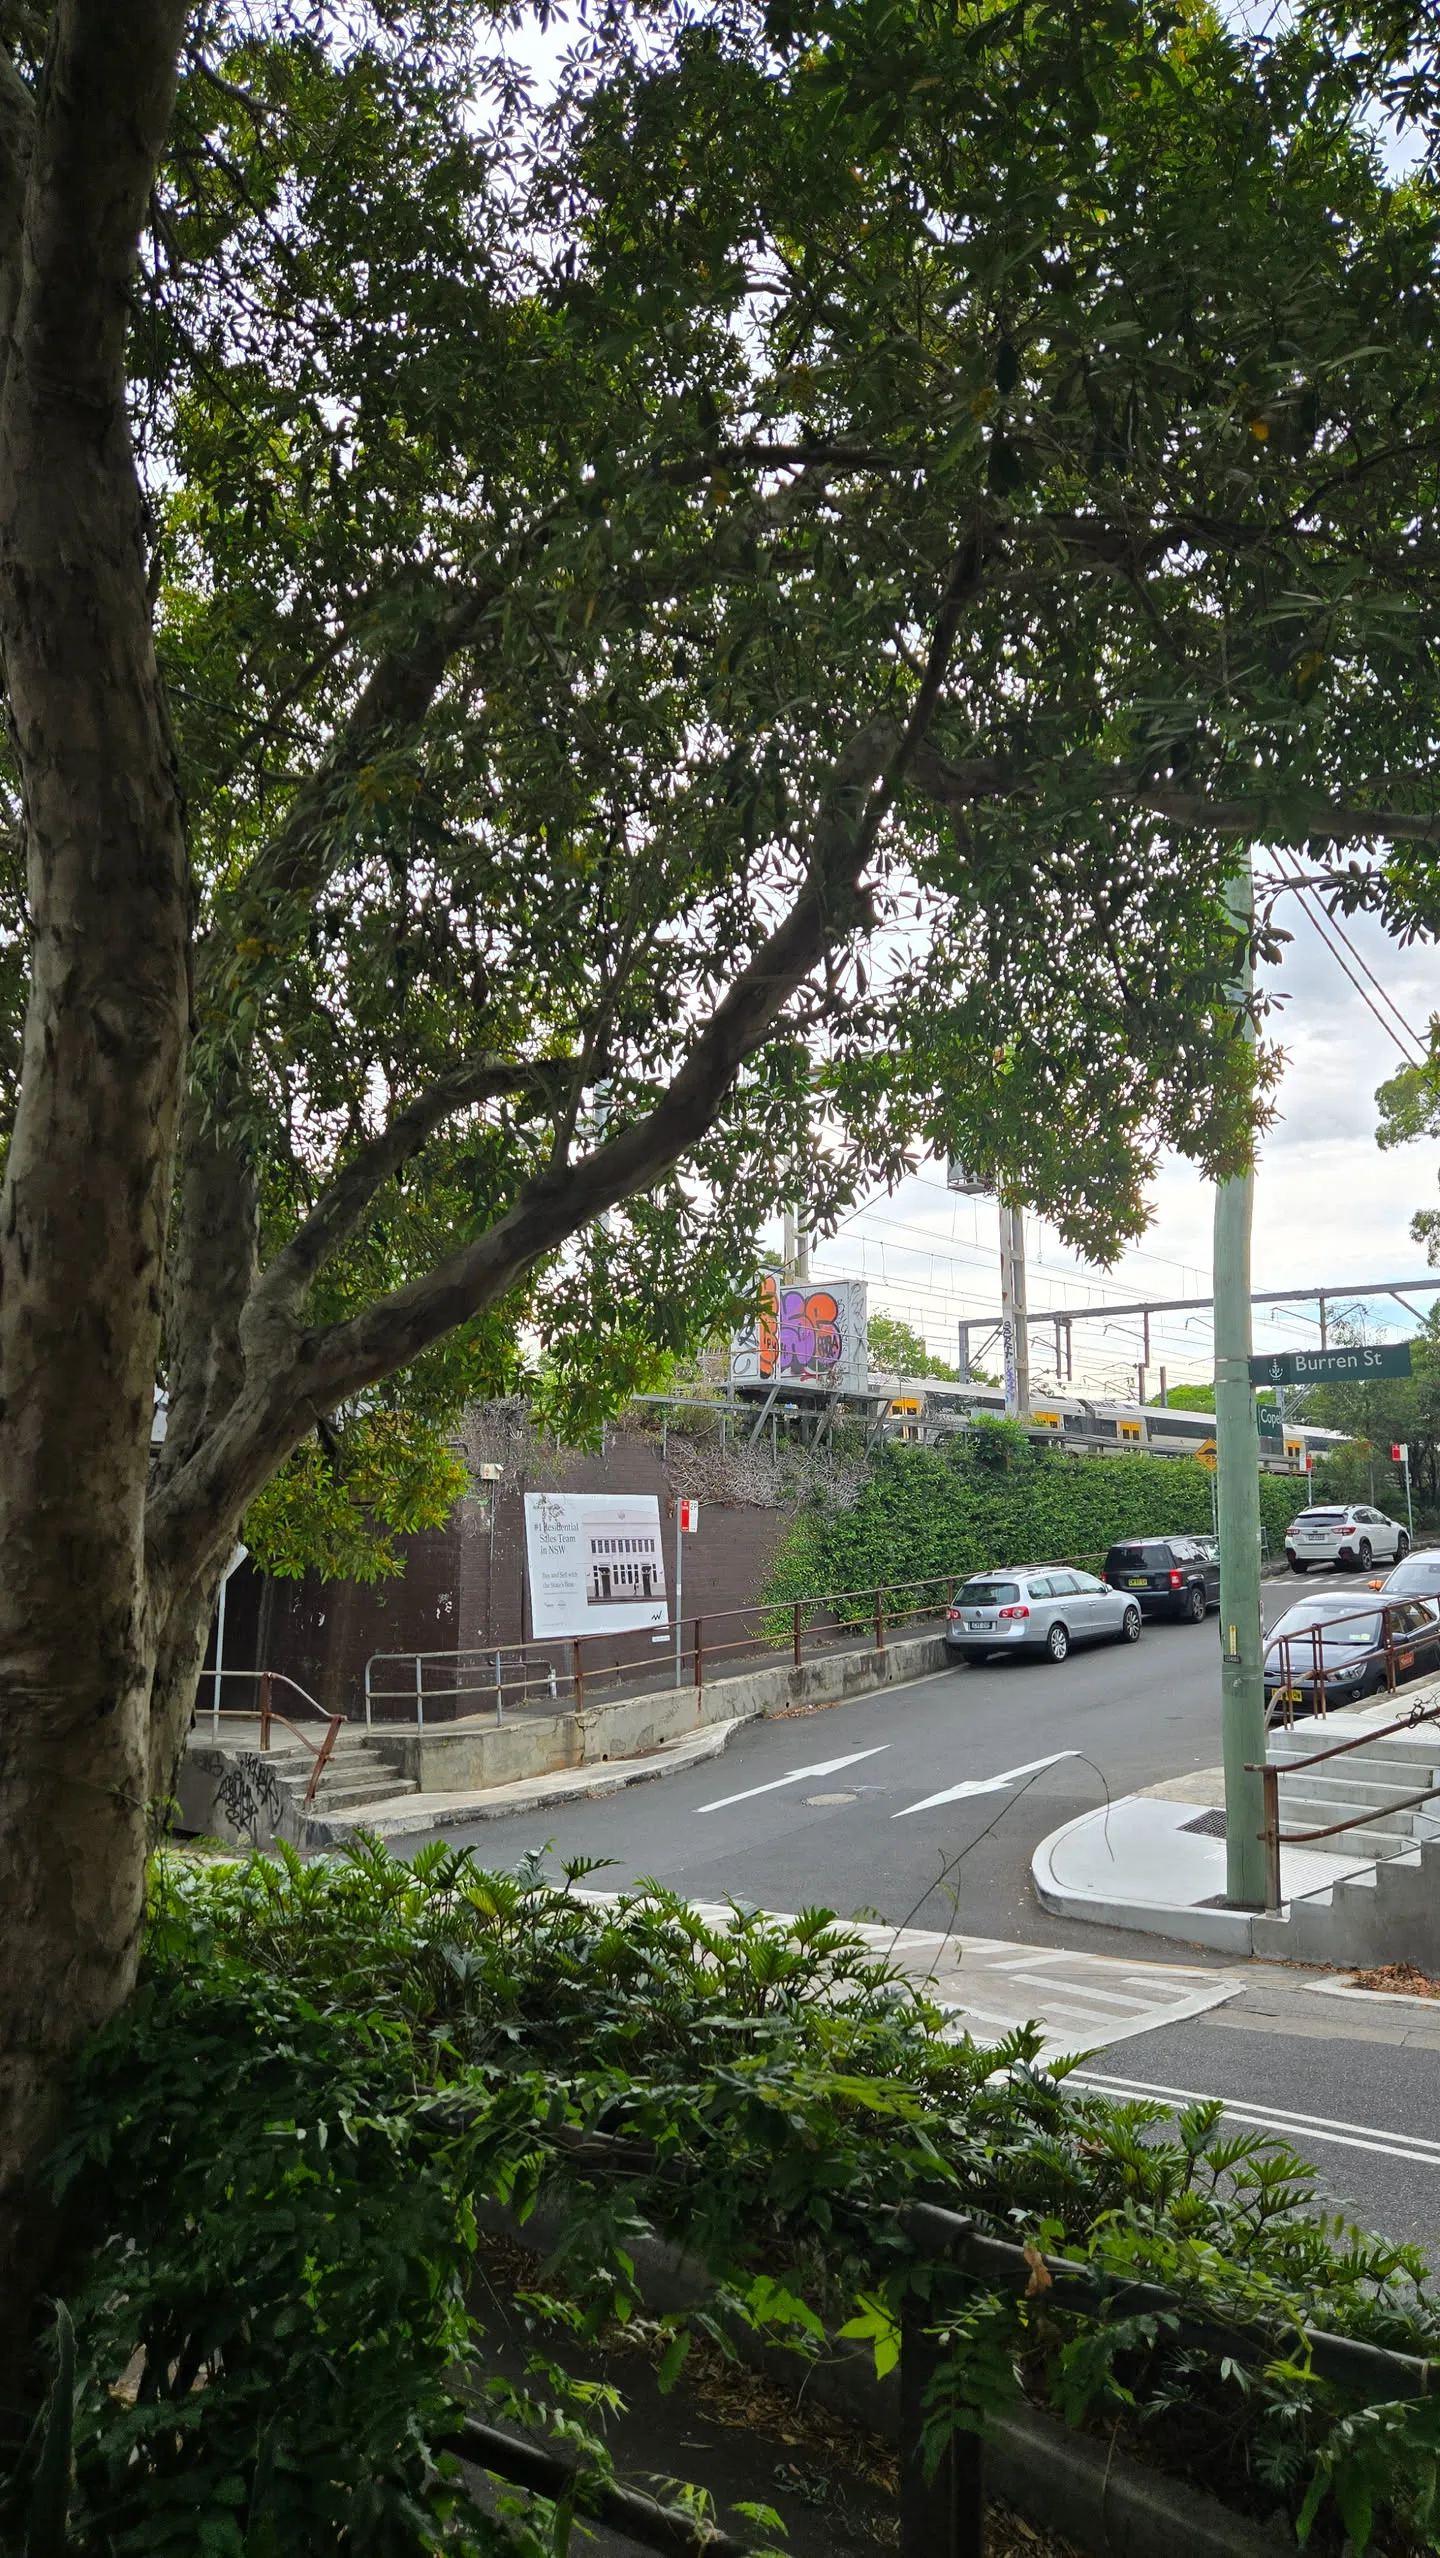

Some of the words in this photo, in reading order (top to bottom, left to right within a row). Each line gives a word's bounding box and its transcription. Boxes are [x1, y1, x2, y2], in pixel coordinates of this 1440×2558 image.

[1295, 1356, 1357, 1371] Burren
[1364, 1351, 1382, 1366] St
[544, 1522, 579, 1532] Residential
[540, 1534, 557, 1543] Sales
[558, 1533, 577, 1543] Team
[541, 1545, 548, 1555] in
[549, 1545, 566, 1554] NSW
